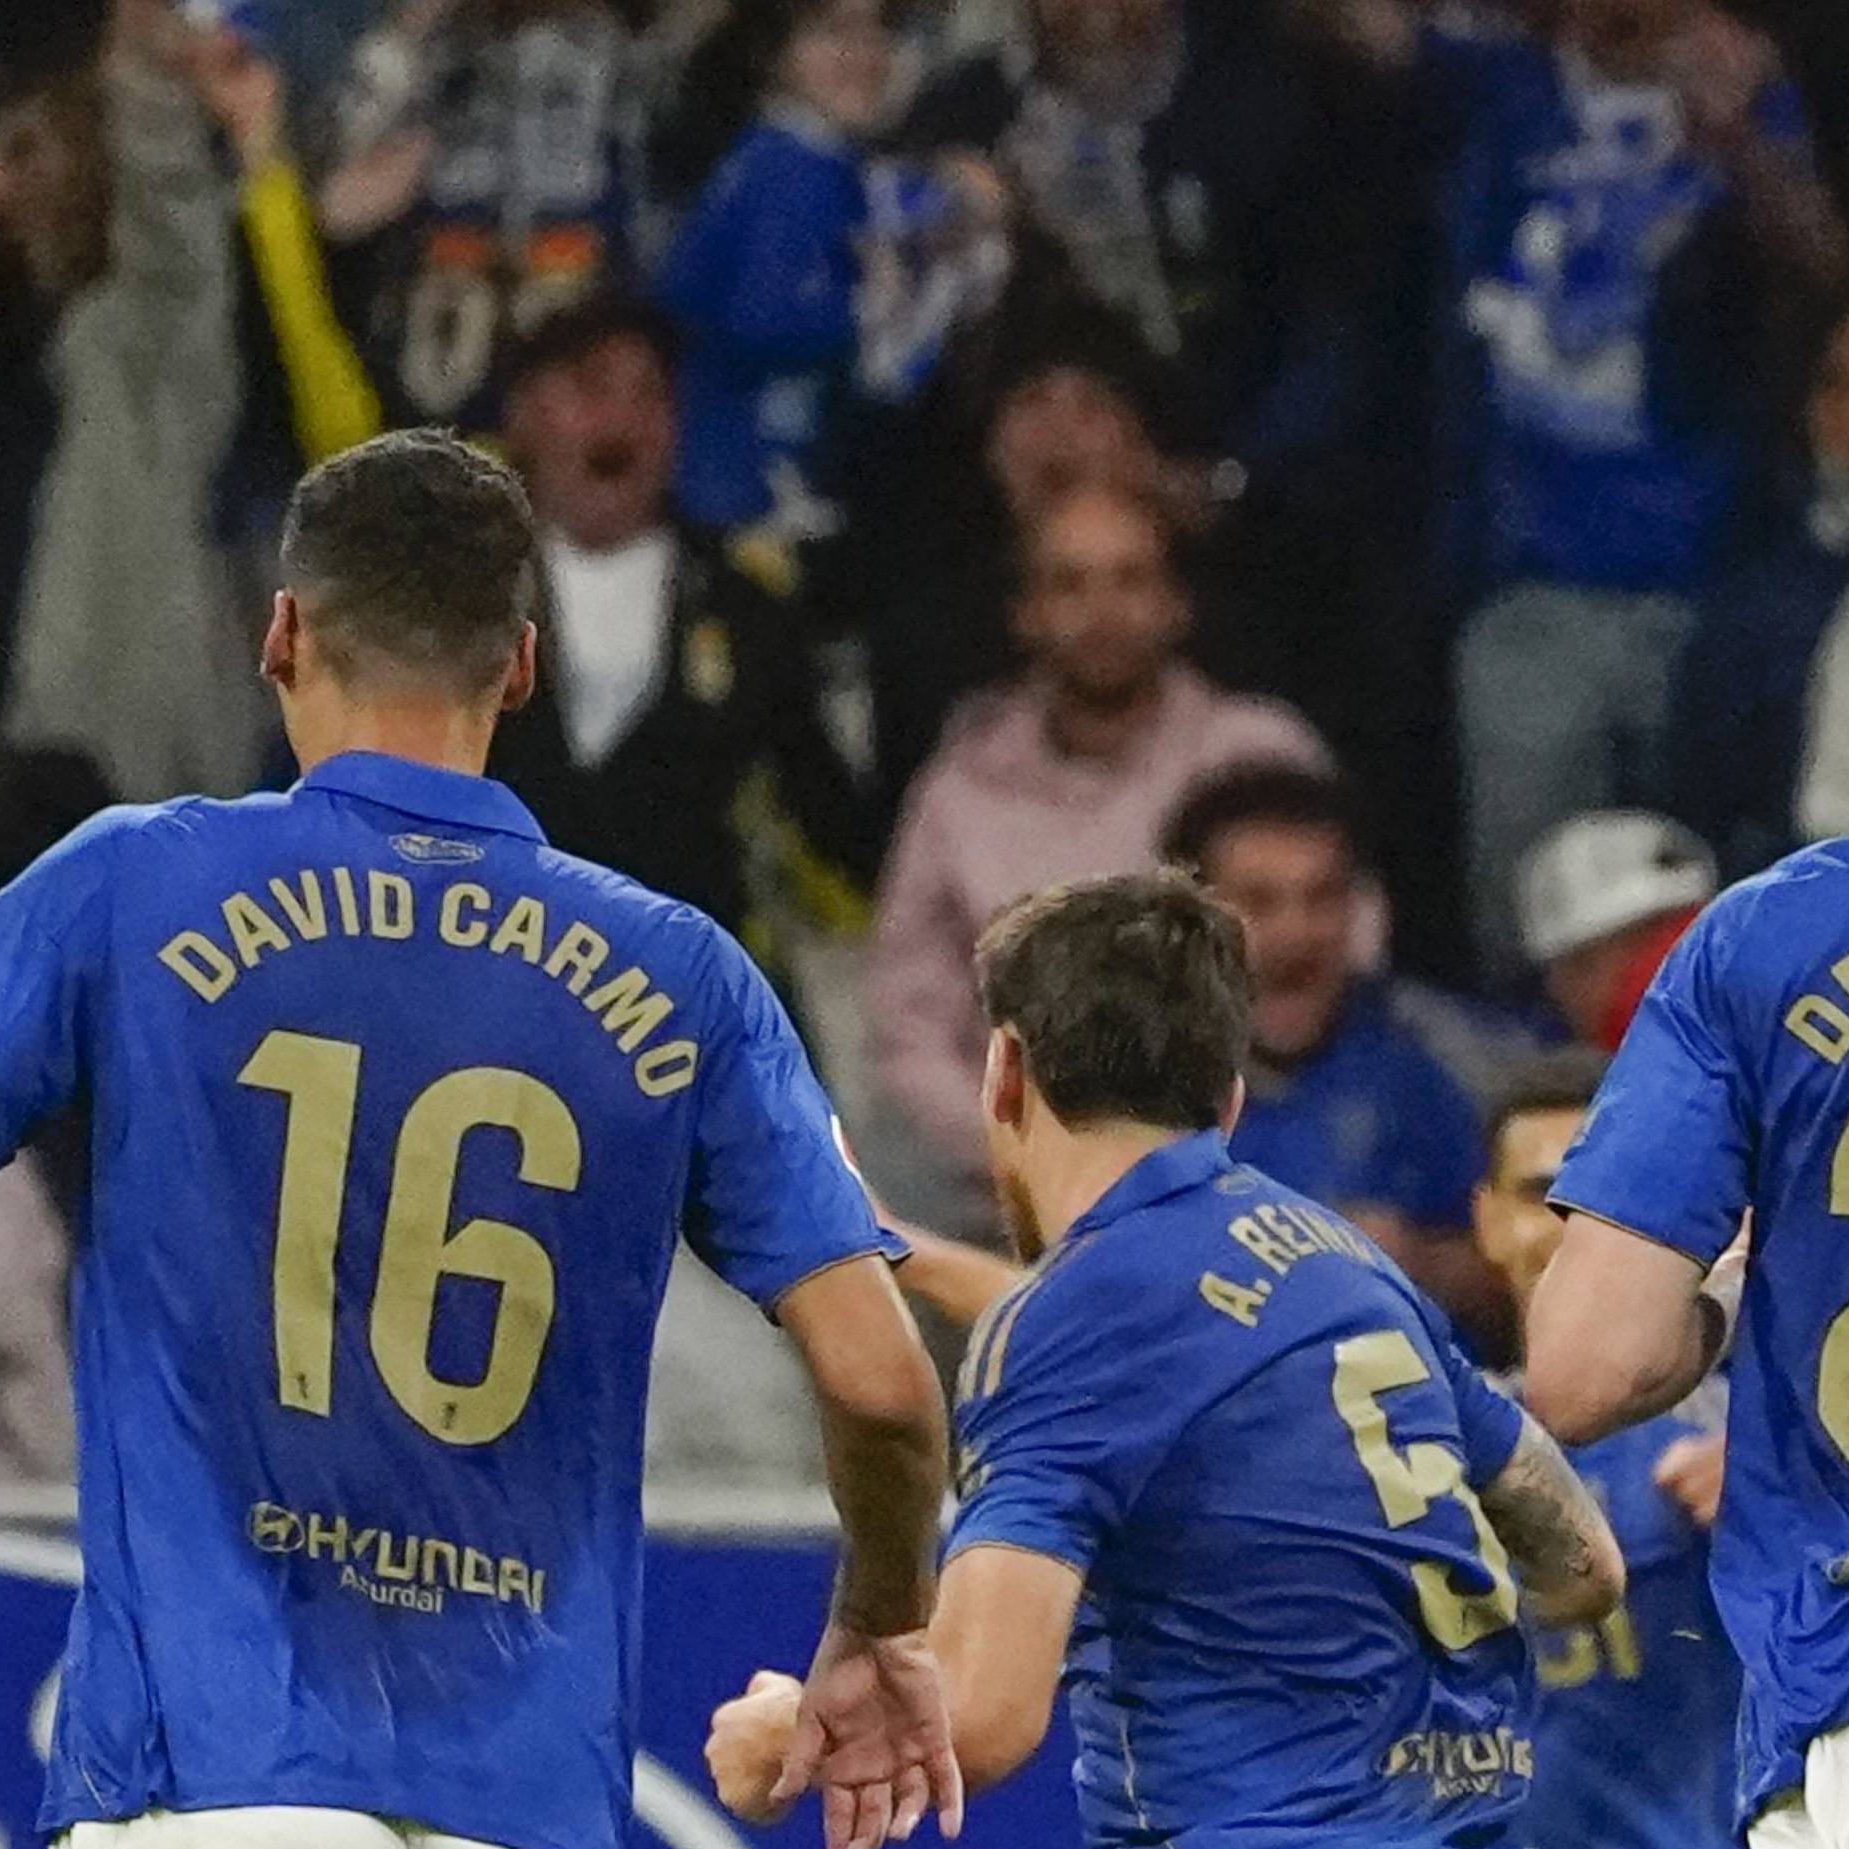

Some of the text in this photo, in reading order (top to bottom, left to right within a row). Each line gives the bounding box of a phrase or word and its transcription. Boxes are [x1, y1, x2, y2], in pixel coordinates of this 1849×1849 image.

[158, 866, 701, 1099] DAVID CARMO
[236, 1028, 583, 1446] 16
[1198, 1270, 1273, 1328] A.
[1331, 1329, 1519, 1651] 5
